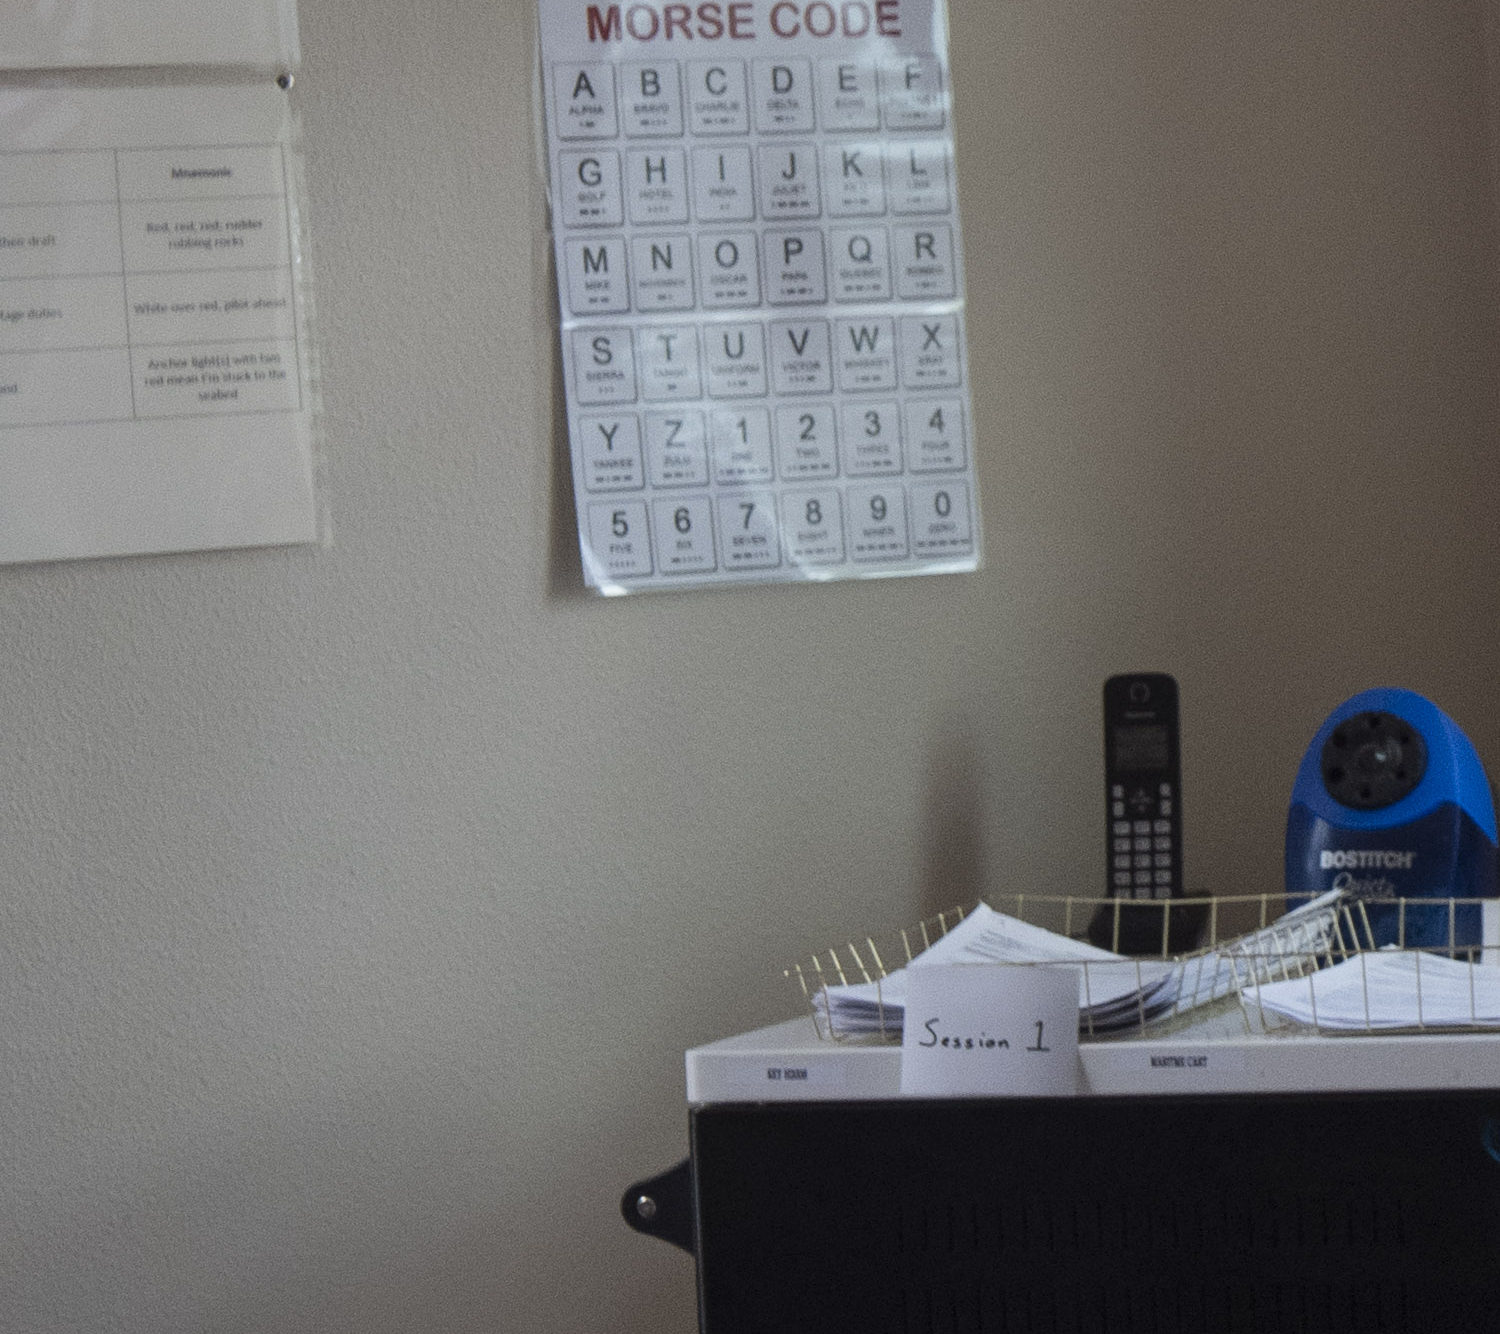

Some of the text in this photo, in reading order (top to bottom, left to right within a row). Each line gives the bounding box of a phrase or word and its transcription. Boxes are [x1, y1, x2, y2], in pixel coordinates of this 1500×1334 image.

[586, 0, 903, 43] MORSE CODE
[572, 64, 921, 99] A B C D E F
[578, 149, 927, 186] G H I J K L
[582, 232, 936, 274] M N O P Q R
[592, 323, 942, 366] S T U V W X
[598, 407, 945, 452] Y Z 1 2 3 4
[611, 510, 629, 539] 5
[673, 507, 691, 534] 6
[738, 502, 756, 530] 7
[806, 498, 822, 525] 8
[870, 494, 887, 521] 9
[1320, 849, 1414, 869] BOSTITCH
[917, 1018, 1051, 1053] Session 1
